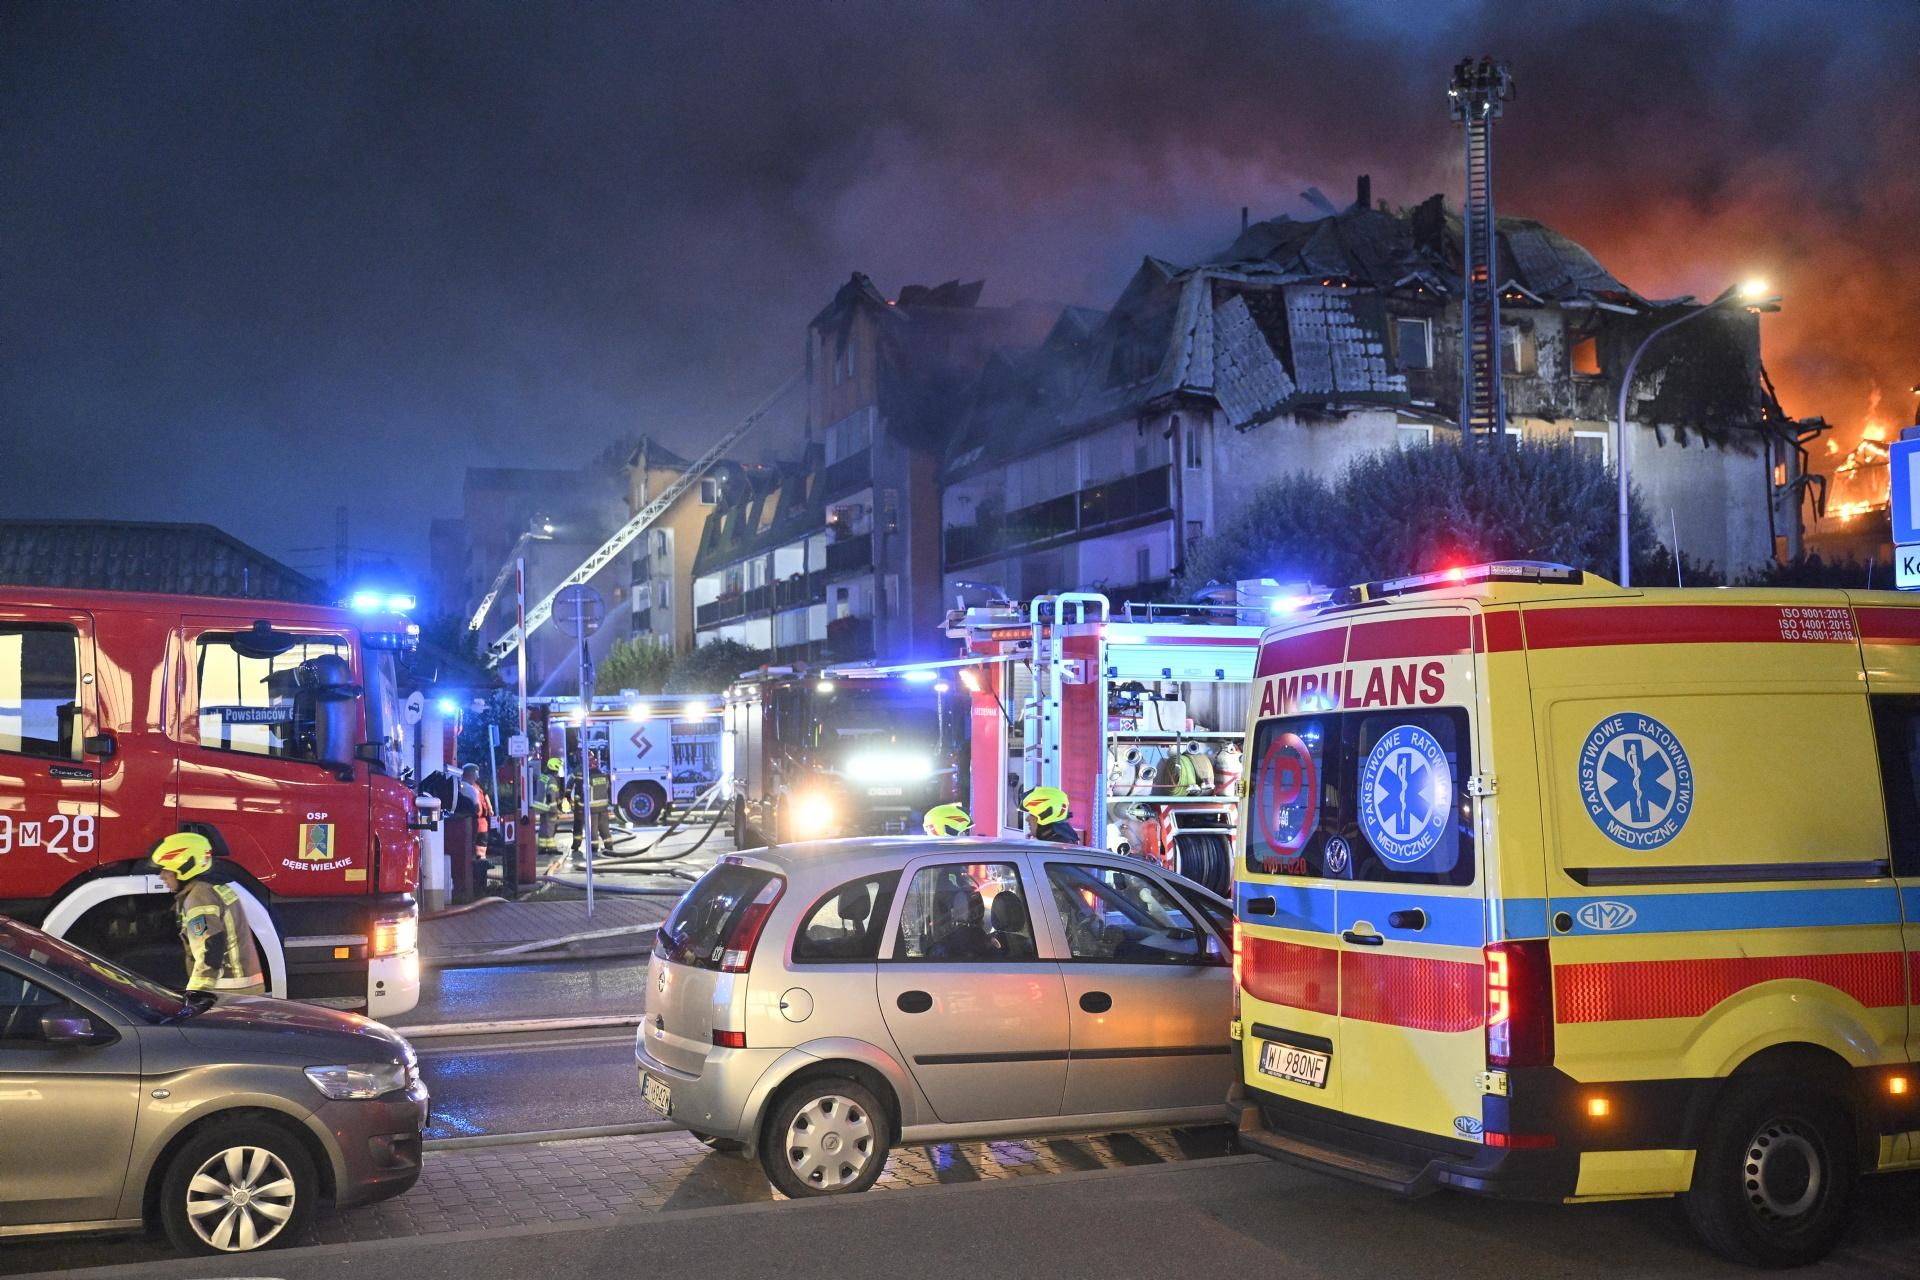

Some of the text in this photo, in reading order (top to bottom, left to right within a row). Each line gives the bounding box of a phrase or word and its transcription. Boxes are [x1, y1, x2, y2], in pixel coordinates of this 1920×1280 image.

[1781, 608, 1848, 619] ISO 9001:2015
[1778, 619, 1851, 630] ISO 14001:2015
[1781, 630, 1854, 641] ISO 45001:2018
[1259, 661, 1445, 717] AMBULANS
[226, 707, 286, 721] Powstańców
[1363, 732, 1401, 826] PAŃSTWOWE
[1581, 718, 1691, 845] PAŃSTWOWE RATOWNICTWO MEDYCZNE
[306, 812, 328, 820] OSP
[22, 825, 38, 844] M
[47, 815, 94, 853] 28
[1376, 830, 1433, 857] MEDYCZNE
[282, 857, 353, 871] DĘBE WIELKIE
[1267, 1047, 1324, 1079] WI 980NF
